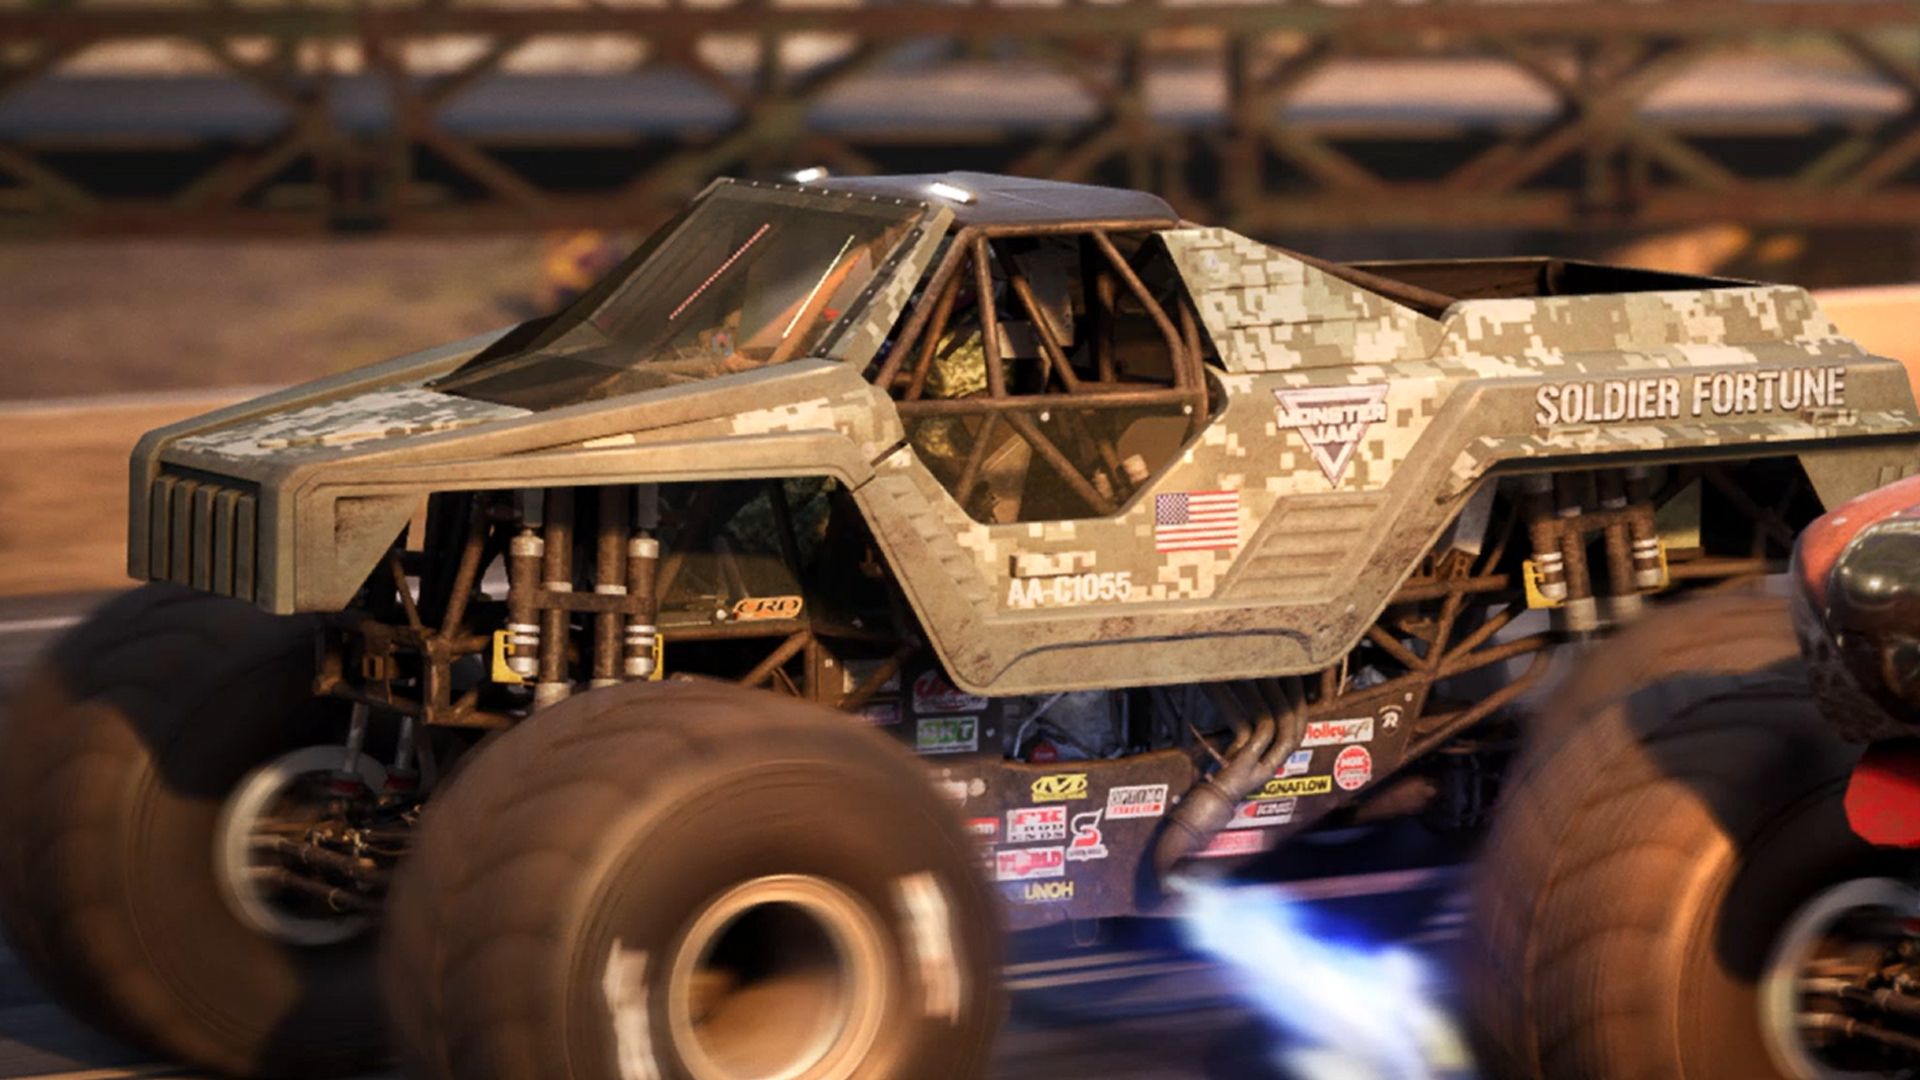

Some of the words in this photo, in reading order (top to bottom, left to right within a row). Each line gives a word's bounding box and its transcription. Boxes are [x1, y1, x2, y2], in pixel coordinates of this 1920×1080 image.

[1535, 375, 1681, 424] SOLDIER
[1691, 366, 1846, 415] FORTUNE
[1278, 402, 1387, 428] MONSTER
[1312, 421, 1364, 444] JAM
[1007, 571, 1133, 605] AA-C1055
[1024, 881, 1074, 901] UNOH
